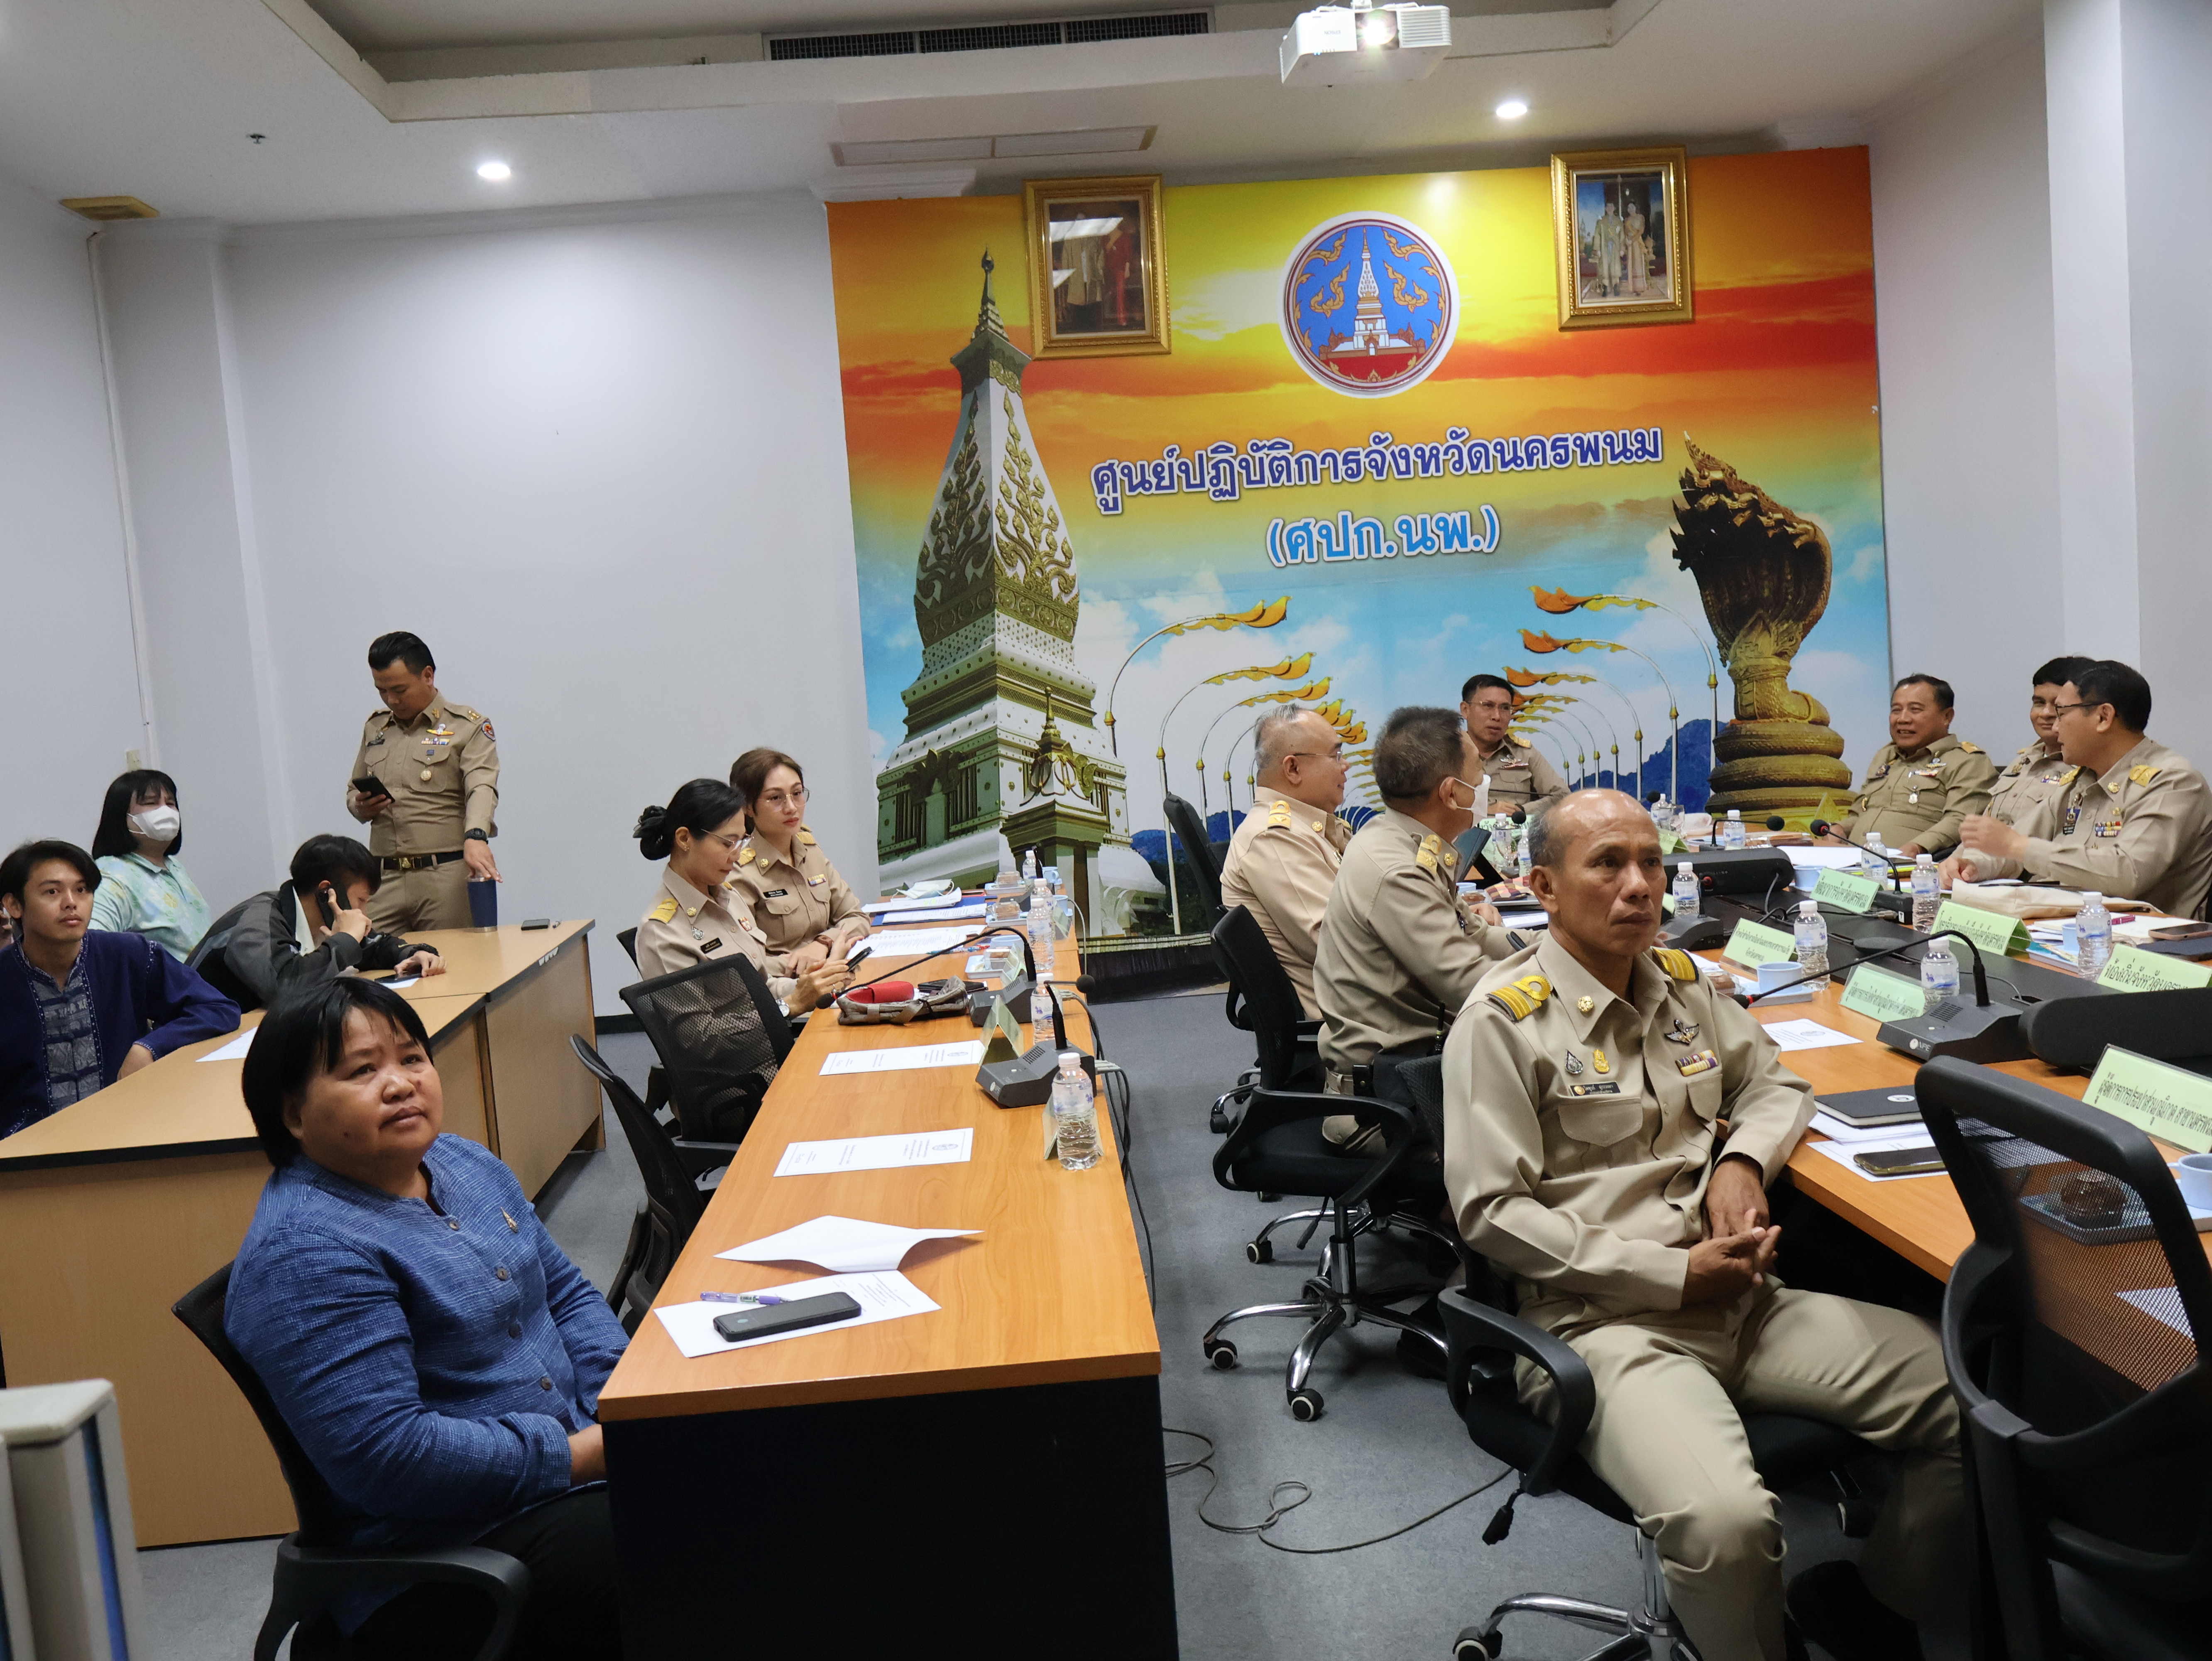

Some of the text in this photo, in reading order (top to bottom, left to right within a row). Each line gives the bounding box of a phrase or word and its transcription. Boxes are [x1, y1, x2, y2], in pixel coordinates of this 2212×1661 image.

[1092, 429, 1661, 512] ศูนย์ปฏิบัติการจังหวัดนครพนม
[1267, 507, 1497, 564] (ศปก.นพ.)
